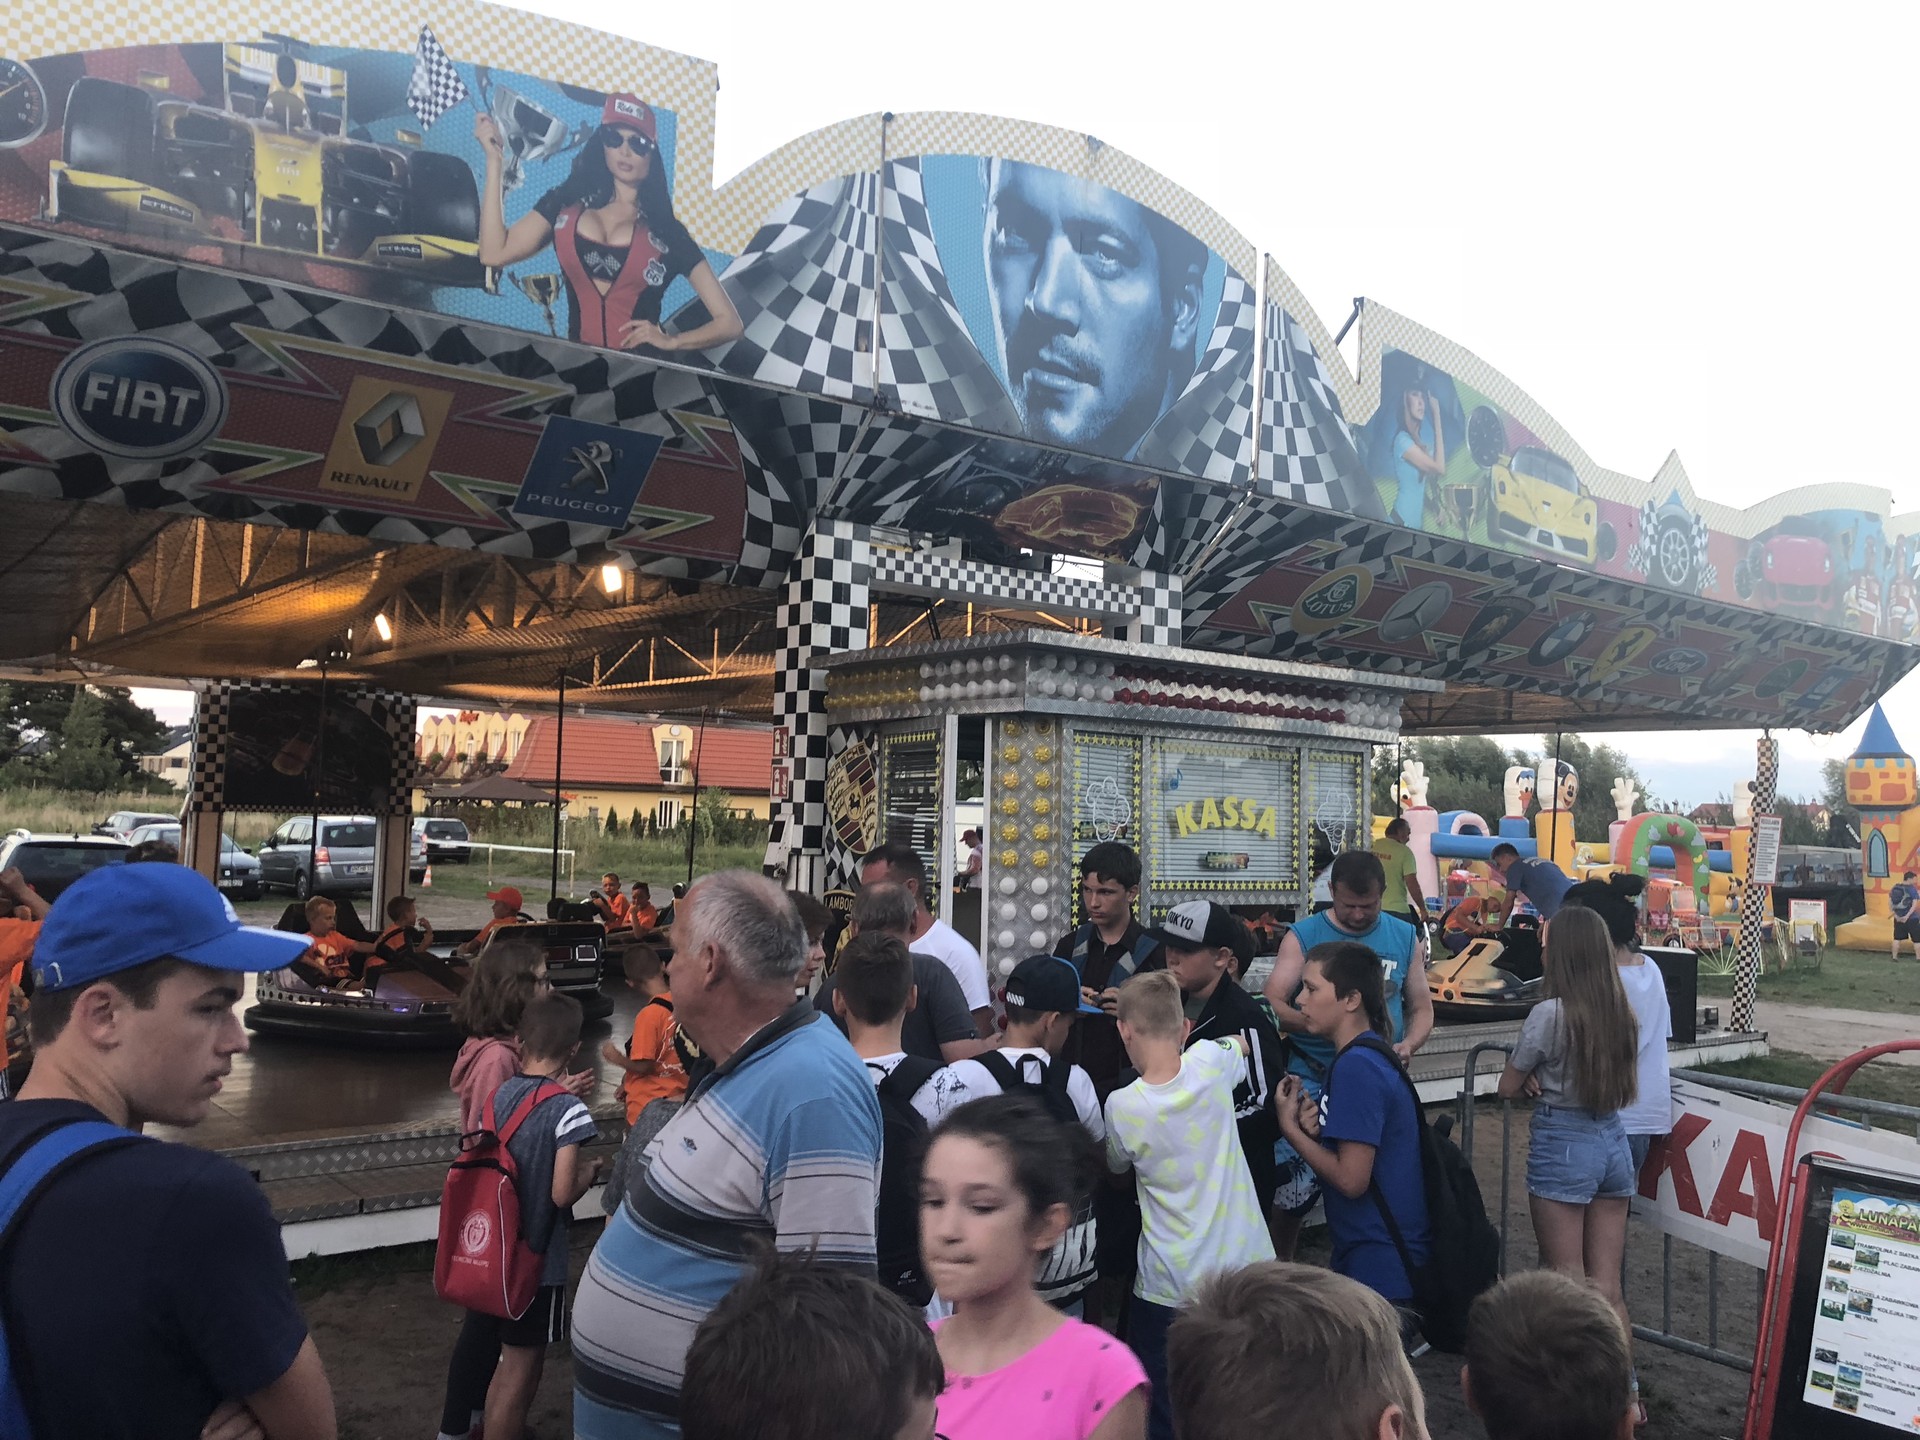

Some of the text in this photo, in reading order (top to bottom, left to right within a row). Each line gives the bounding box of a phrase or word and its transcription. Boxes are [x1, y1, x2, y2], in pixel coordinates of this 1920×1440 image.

[82, 372, 200, 426] FIAT
[330, 470, 414, 493] RENAULT
[526, 492, 623, 516] PEUGEOT
[1305, 594, 1354, 615] LOTUS
[1654, 650, 1699, 674] Ford
[1175, 796, 1277, 838] KASSA
[1637, 1112, 1846, 1242] KA
[1859, 1208, 1920, 1231] LUNAPA
